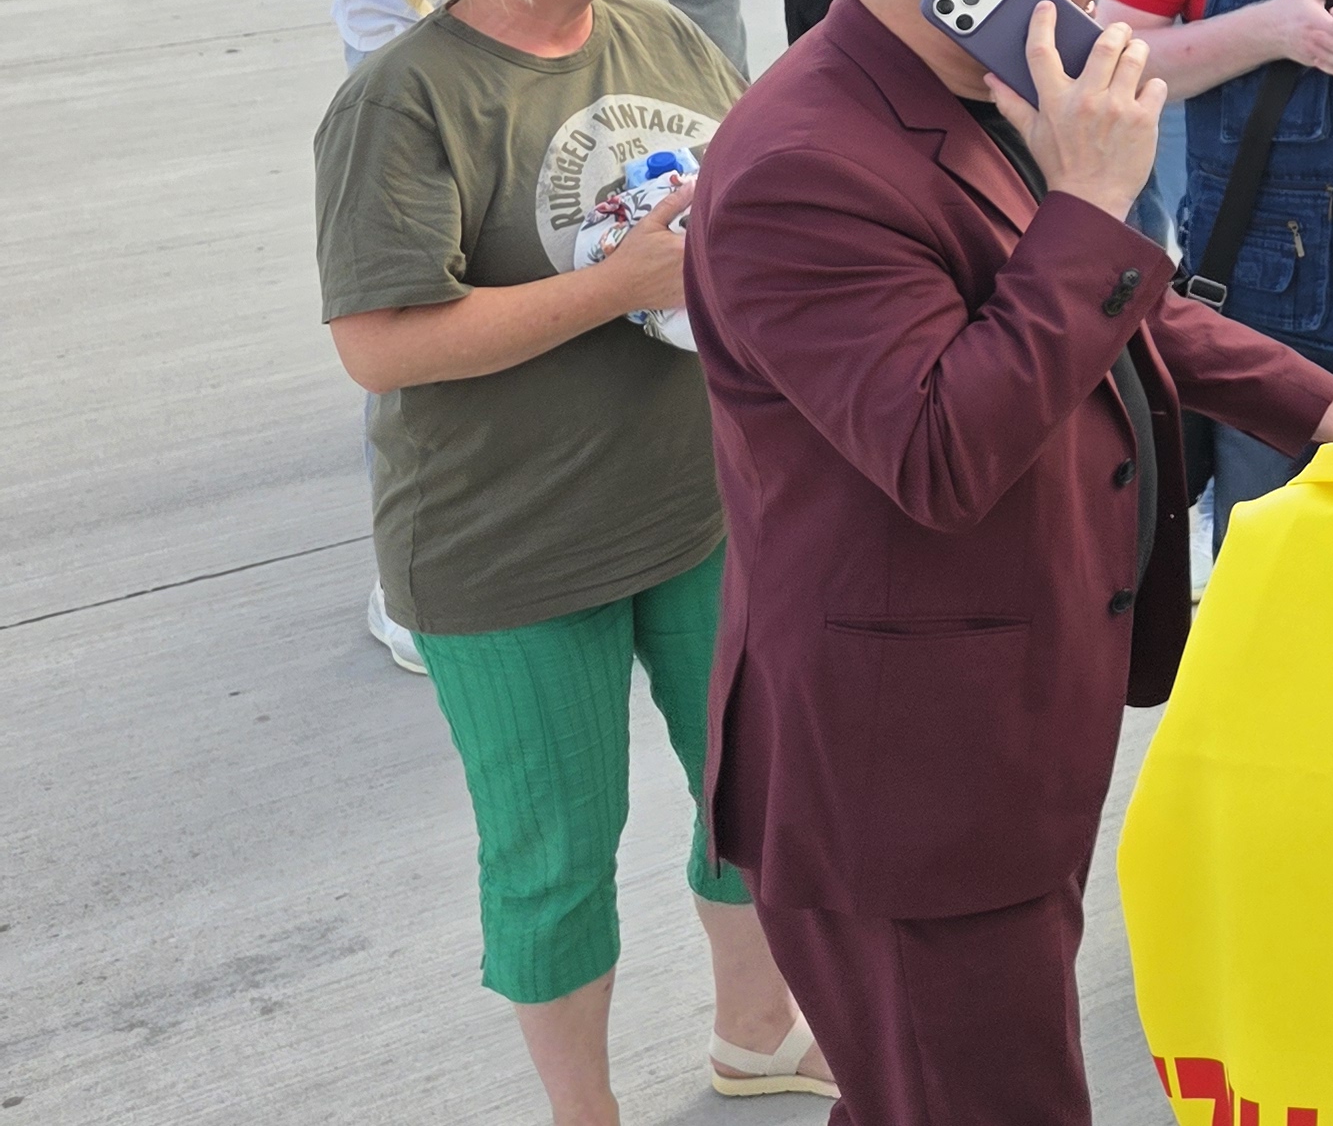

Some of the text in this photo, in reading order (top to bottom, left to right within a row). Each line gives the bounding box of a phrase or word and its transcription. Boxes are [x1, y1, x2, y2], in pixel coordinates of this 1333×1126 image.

[550, 103, 702, 232] RUGGED VINTAGE
[609, 137, 649, 165] 1975
